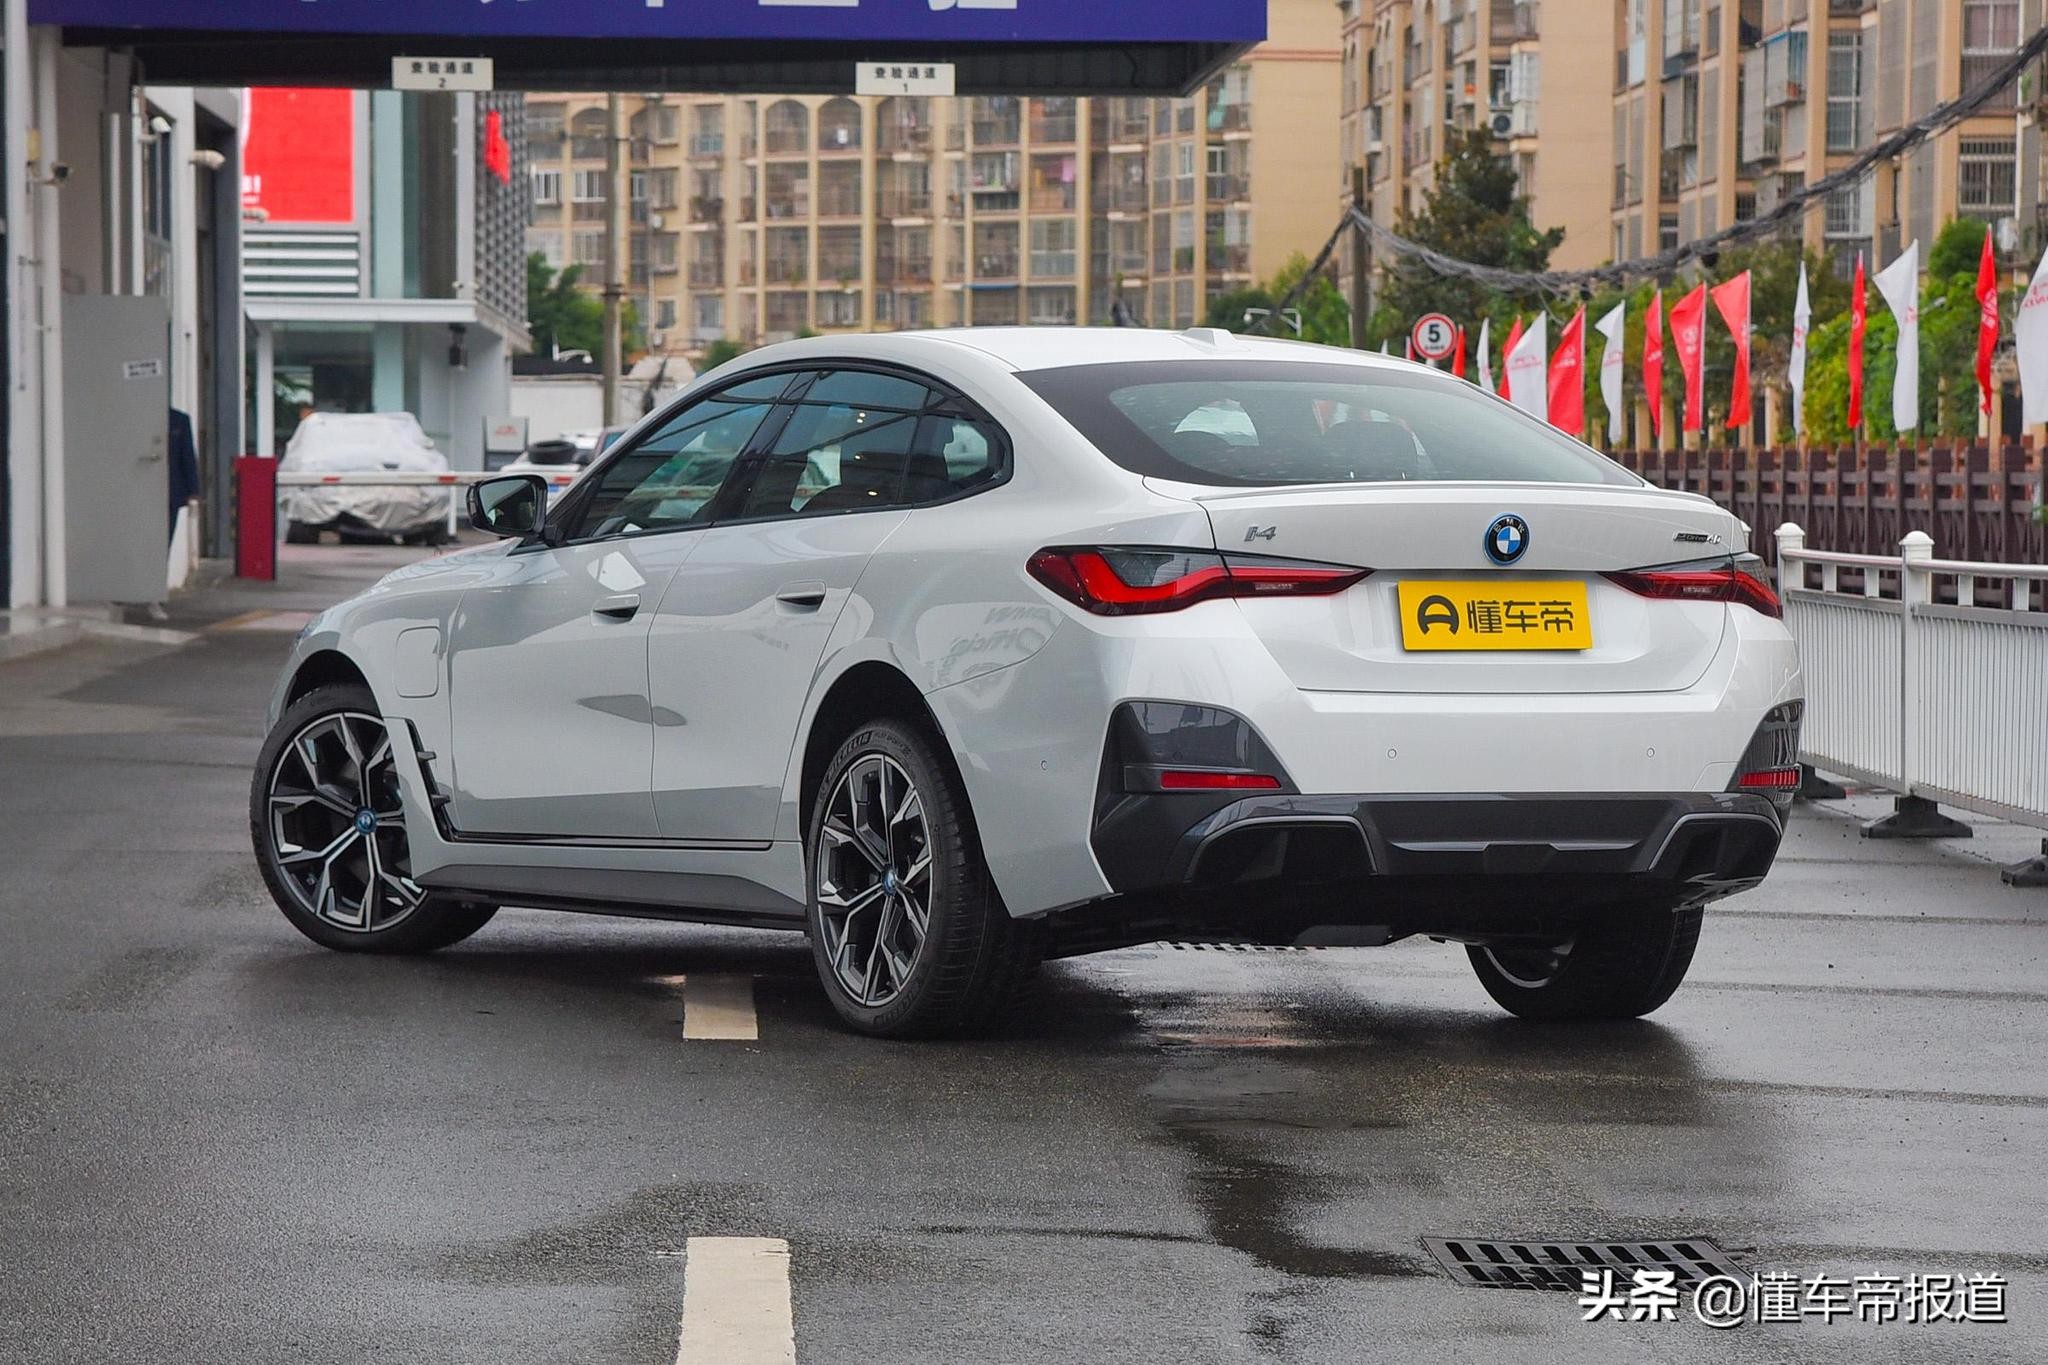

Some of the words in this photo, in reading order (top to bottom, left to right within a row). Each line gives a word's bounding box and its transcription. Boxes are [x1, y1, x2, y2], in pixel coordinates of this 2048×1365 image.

[438, 78, 446, 88] 2
[903, 83, 908, 93] 1
[1428, 323, 1440, 343] 5
[1244, 526, 1276, 541] i4
[1493, 518, 1525, 534] BMW
[1466, 599, 1574, 634] 懂车帝
